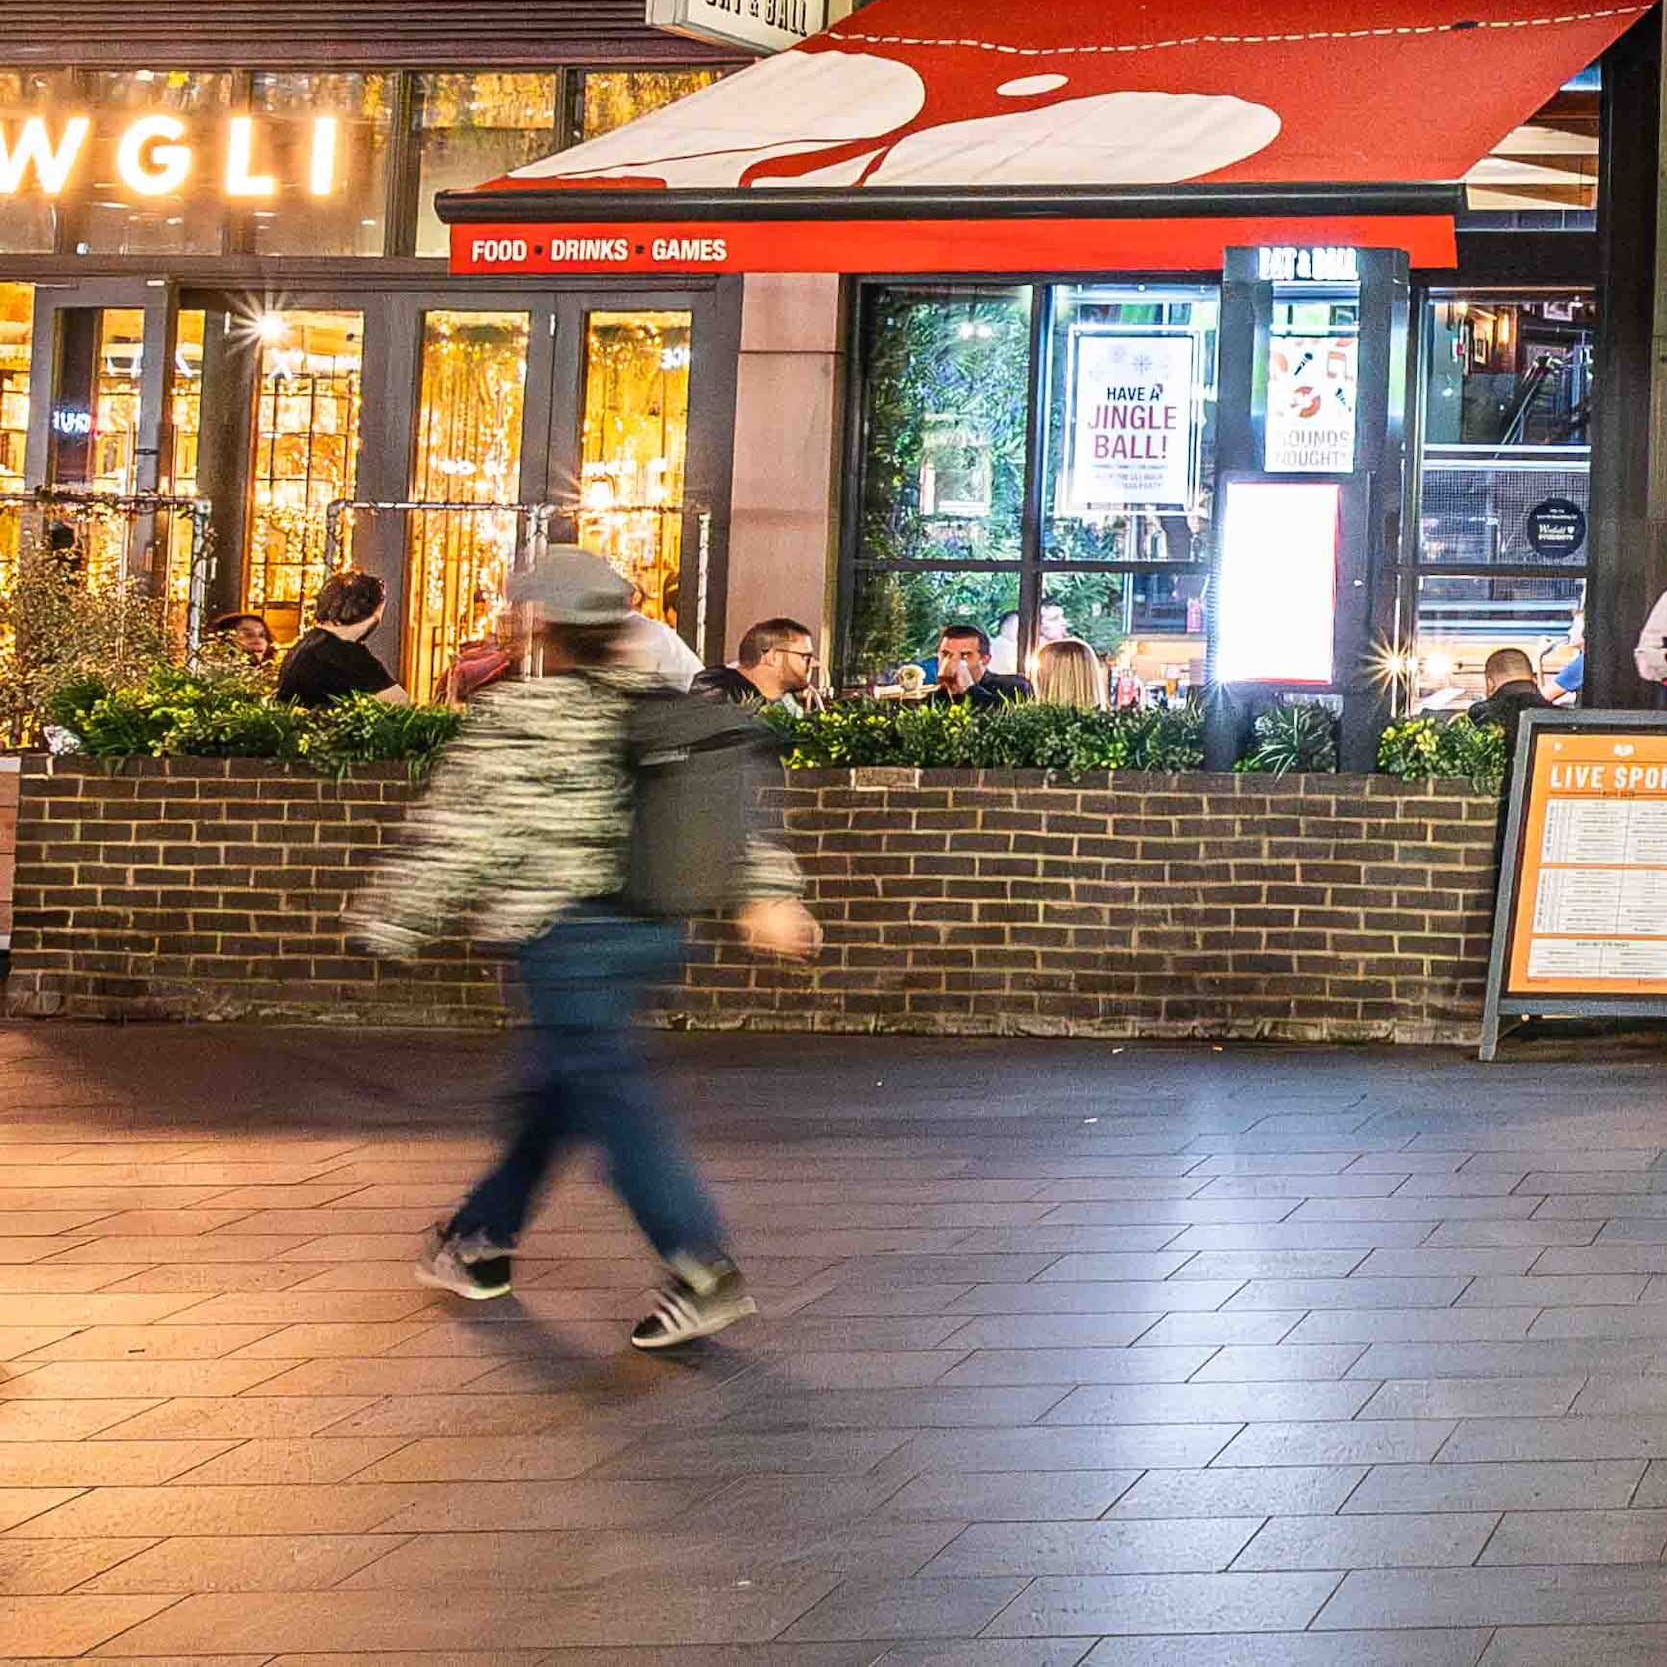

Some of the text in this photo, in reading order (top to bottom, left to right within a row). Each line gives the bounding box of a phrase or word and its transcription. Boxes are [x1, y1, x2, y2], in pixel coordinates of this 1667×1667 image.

[0, 114, 338, 196] WGLI
[471, 238, 728, 262] FOOD DRINKS GAMES
[1107, 386, 1161, 402] HAVE A
[1087, 404, 1177, 430] JINGLE
[1093, 434, 1168, 459] BALL!
[1550, 764, 1606, 789] LIVE
